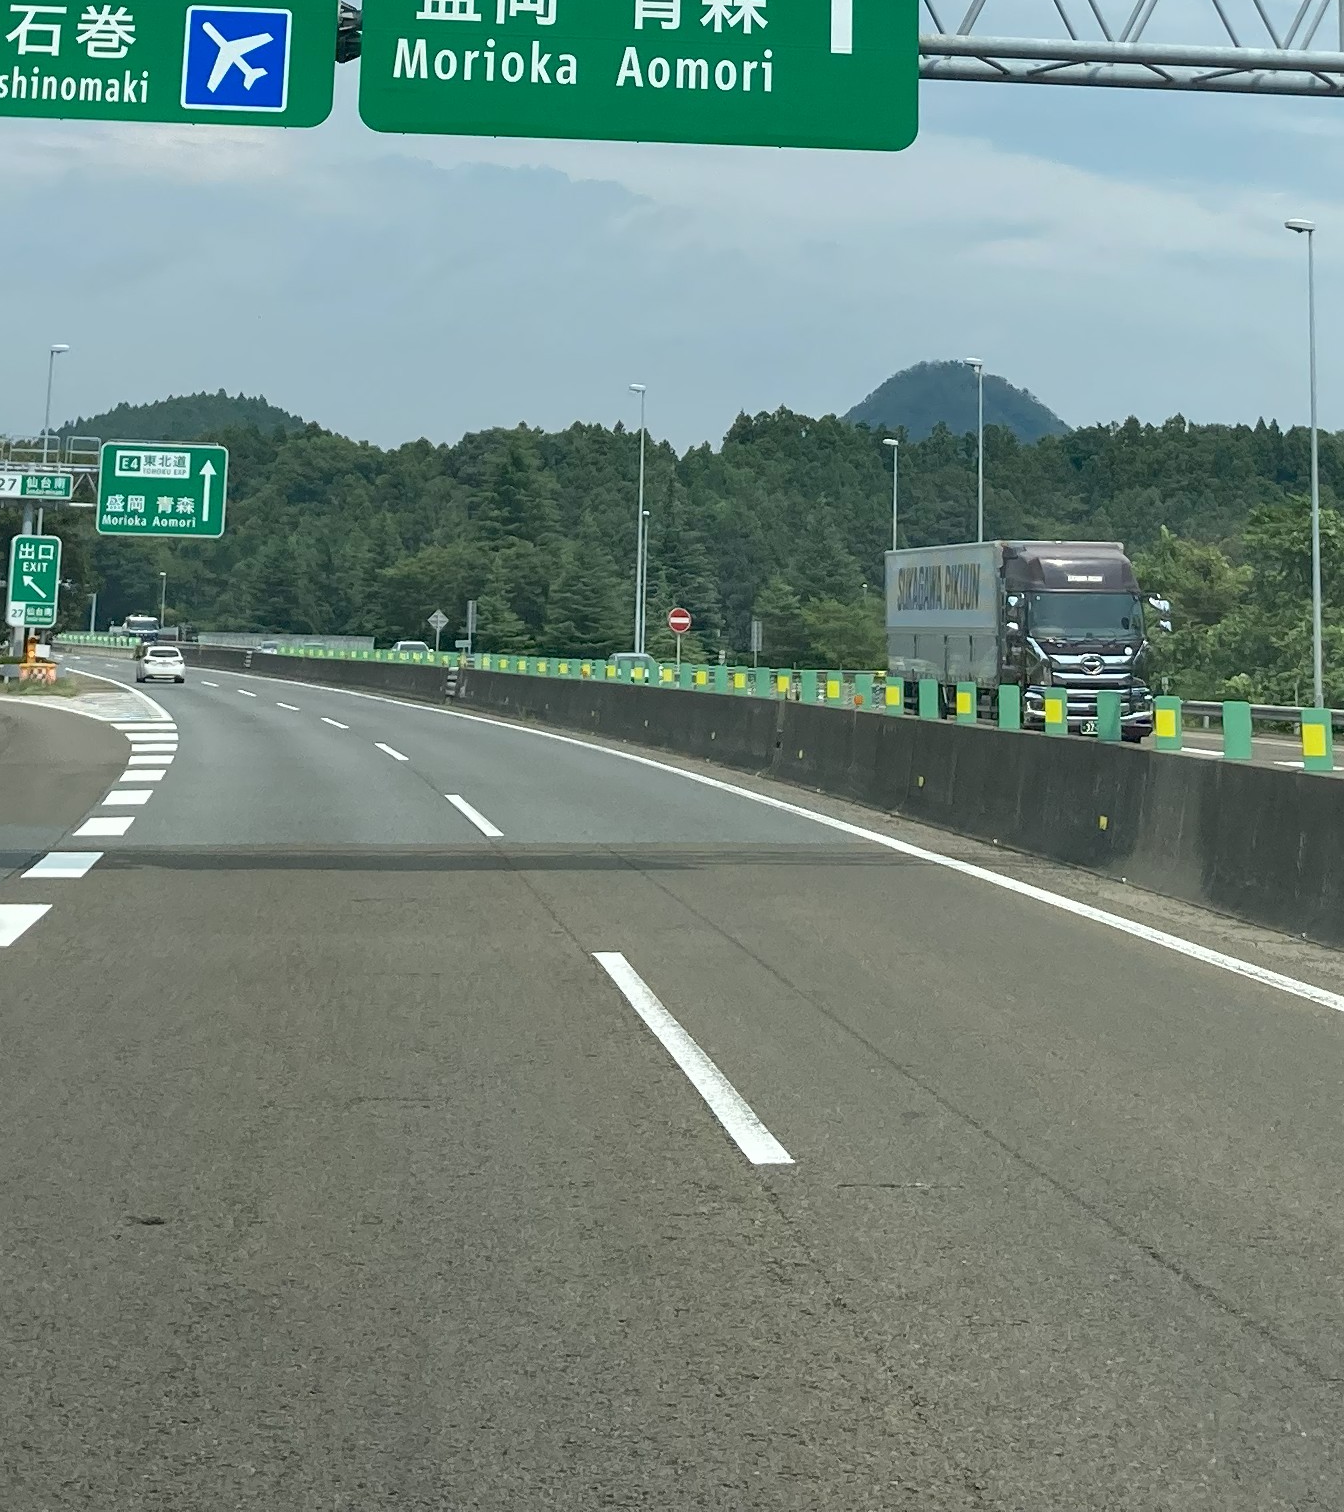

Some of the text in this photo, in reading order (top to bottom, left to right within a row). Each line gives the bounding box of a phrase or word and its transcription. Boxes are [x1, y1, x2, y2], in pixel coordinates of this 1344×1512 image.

[4, 2, 137, 61] 石巻
[392, 37, 774, 93] Morioka Aomori
[121, 457, 138, 469] E4
[143, 454, 187, 468] 東北道
[26, 476, 66, 489] 仙台南
[106, 494, 195, 515] 盛岡 青森
[101, 514, 197, 528] Morioka Aomori
[18, 542, 55, 560] 出口
[22, 561, 49, 573] EXIT
[11, 608, 24, 618] 27
